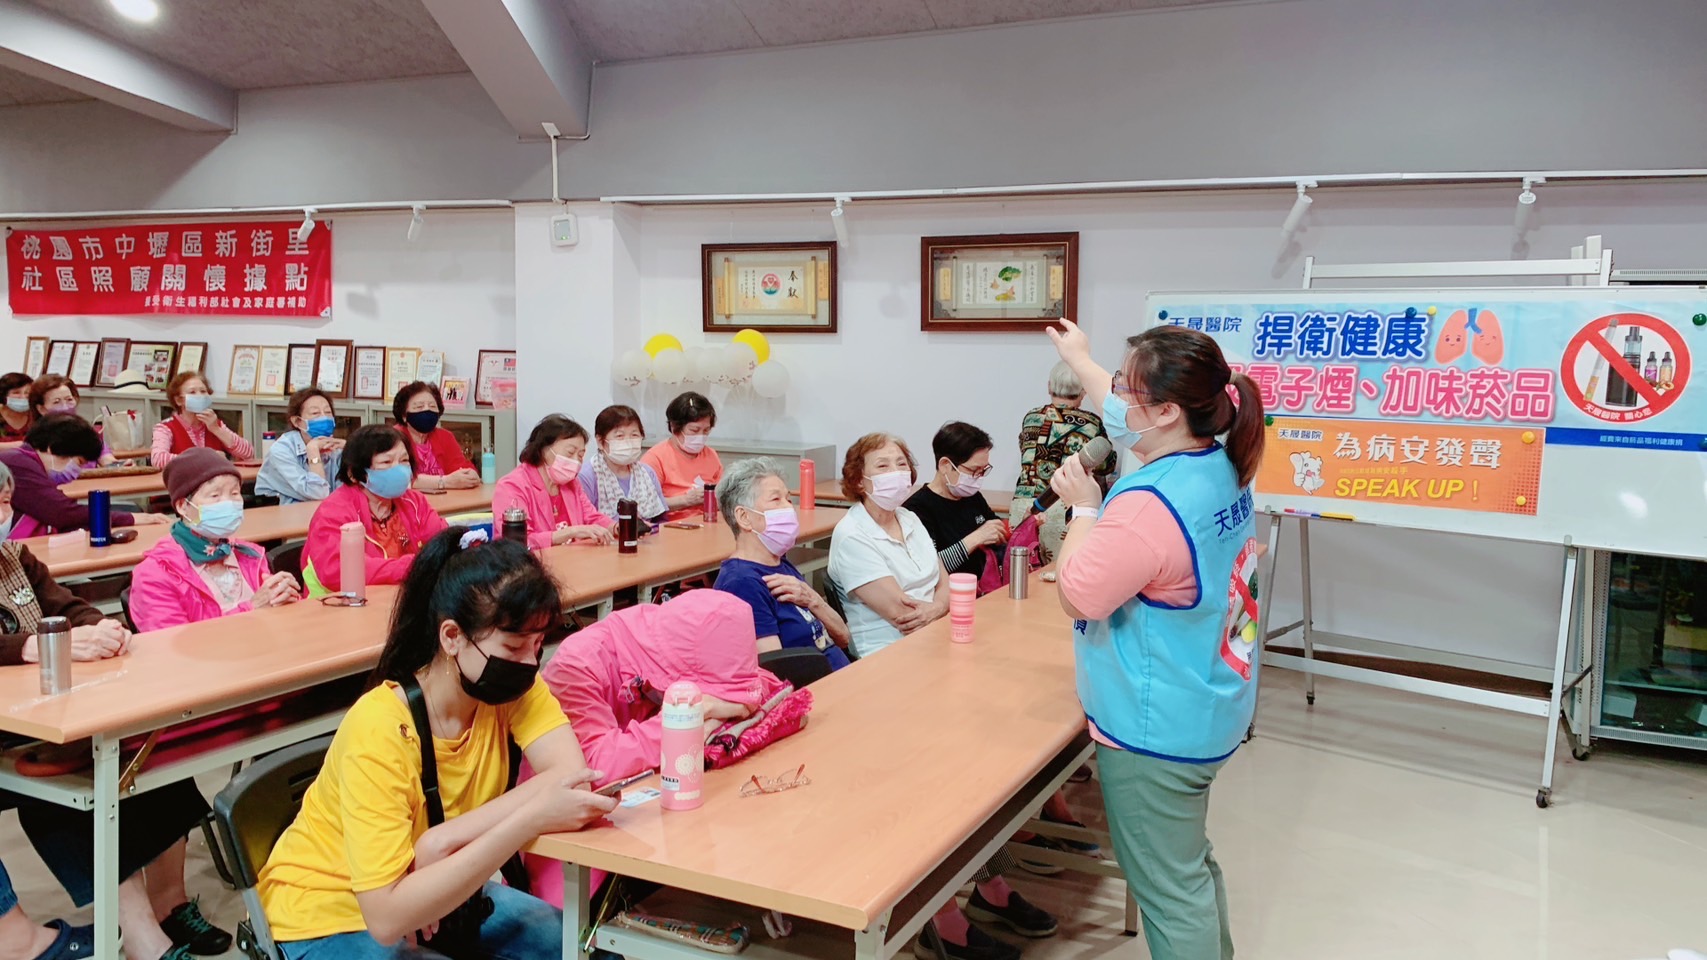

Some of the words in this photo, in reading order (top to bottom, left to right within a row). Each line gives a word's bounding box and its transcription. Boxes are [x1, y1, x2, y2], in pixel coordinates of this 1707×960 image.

[21, 228, 309, 260] 桃園市中壢區新街里
[21, 262, 309, 293] 社區照顧關懷據點
[1255, 312, 1428, 358] 捍衛健康
[1226, 364, 1551, 420] 電子煙、加味菸品
[1279, 428, 1322, 440] 天晟醫院
[1333, 432, 1502, 469] 為病安發聲
[1335, 478, 1421, 498] SPEAK
